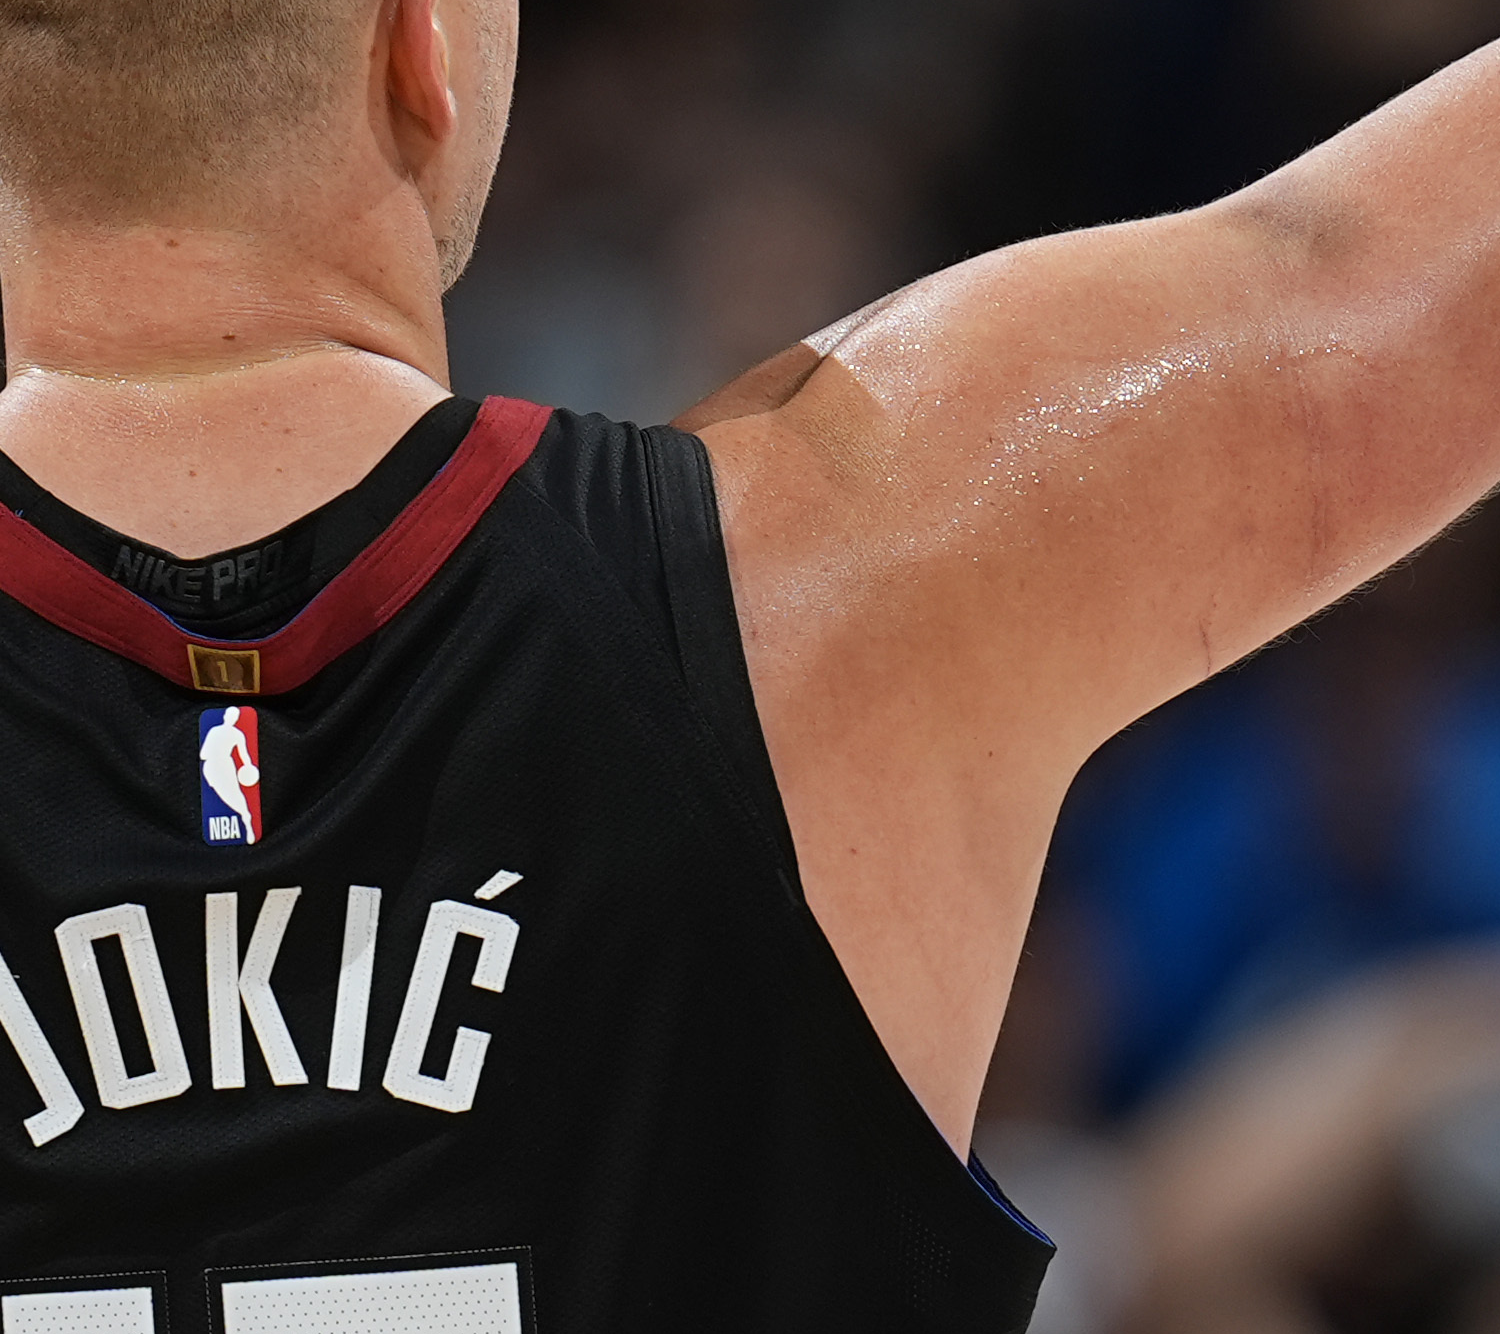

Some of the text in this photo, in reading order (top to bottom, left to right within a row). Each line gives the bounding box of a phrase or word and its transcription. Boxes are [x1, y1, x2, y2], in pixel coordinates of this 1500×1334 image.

[111, 539, 284, 603] NIKE PRO
[208, 815, 241, 841] NBA
